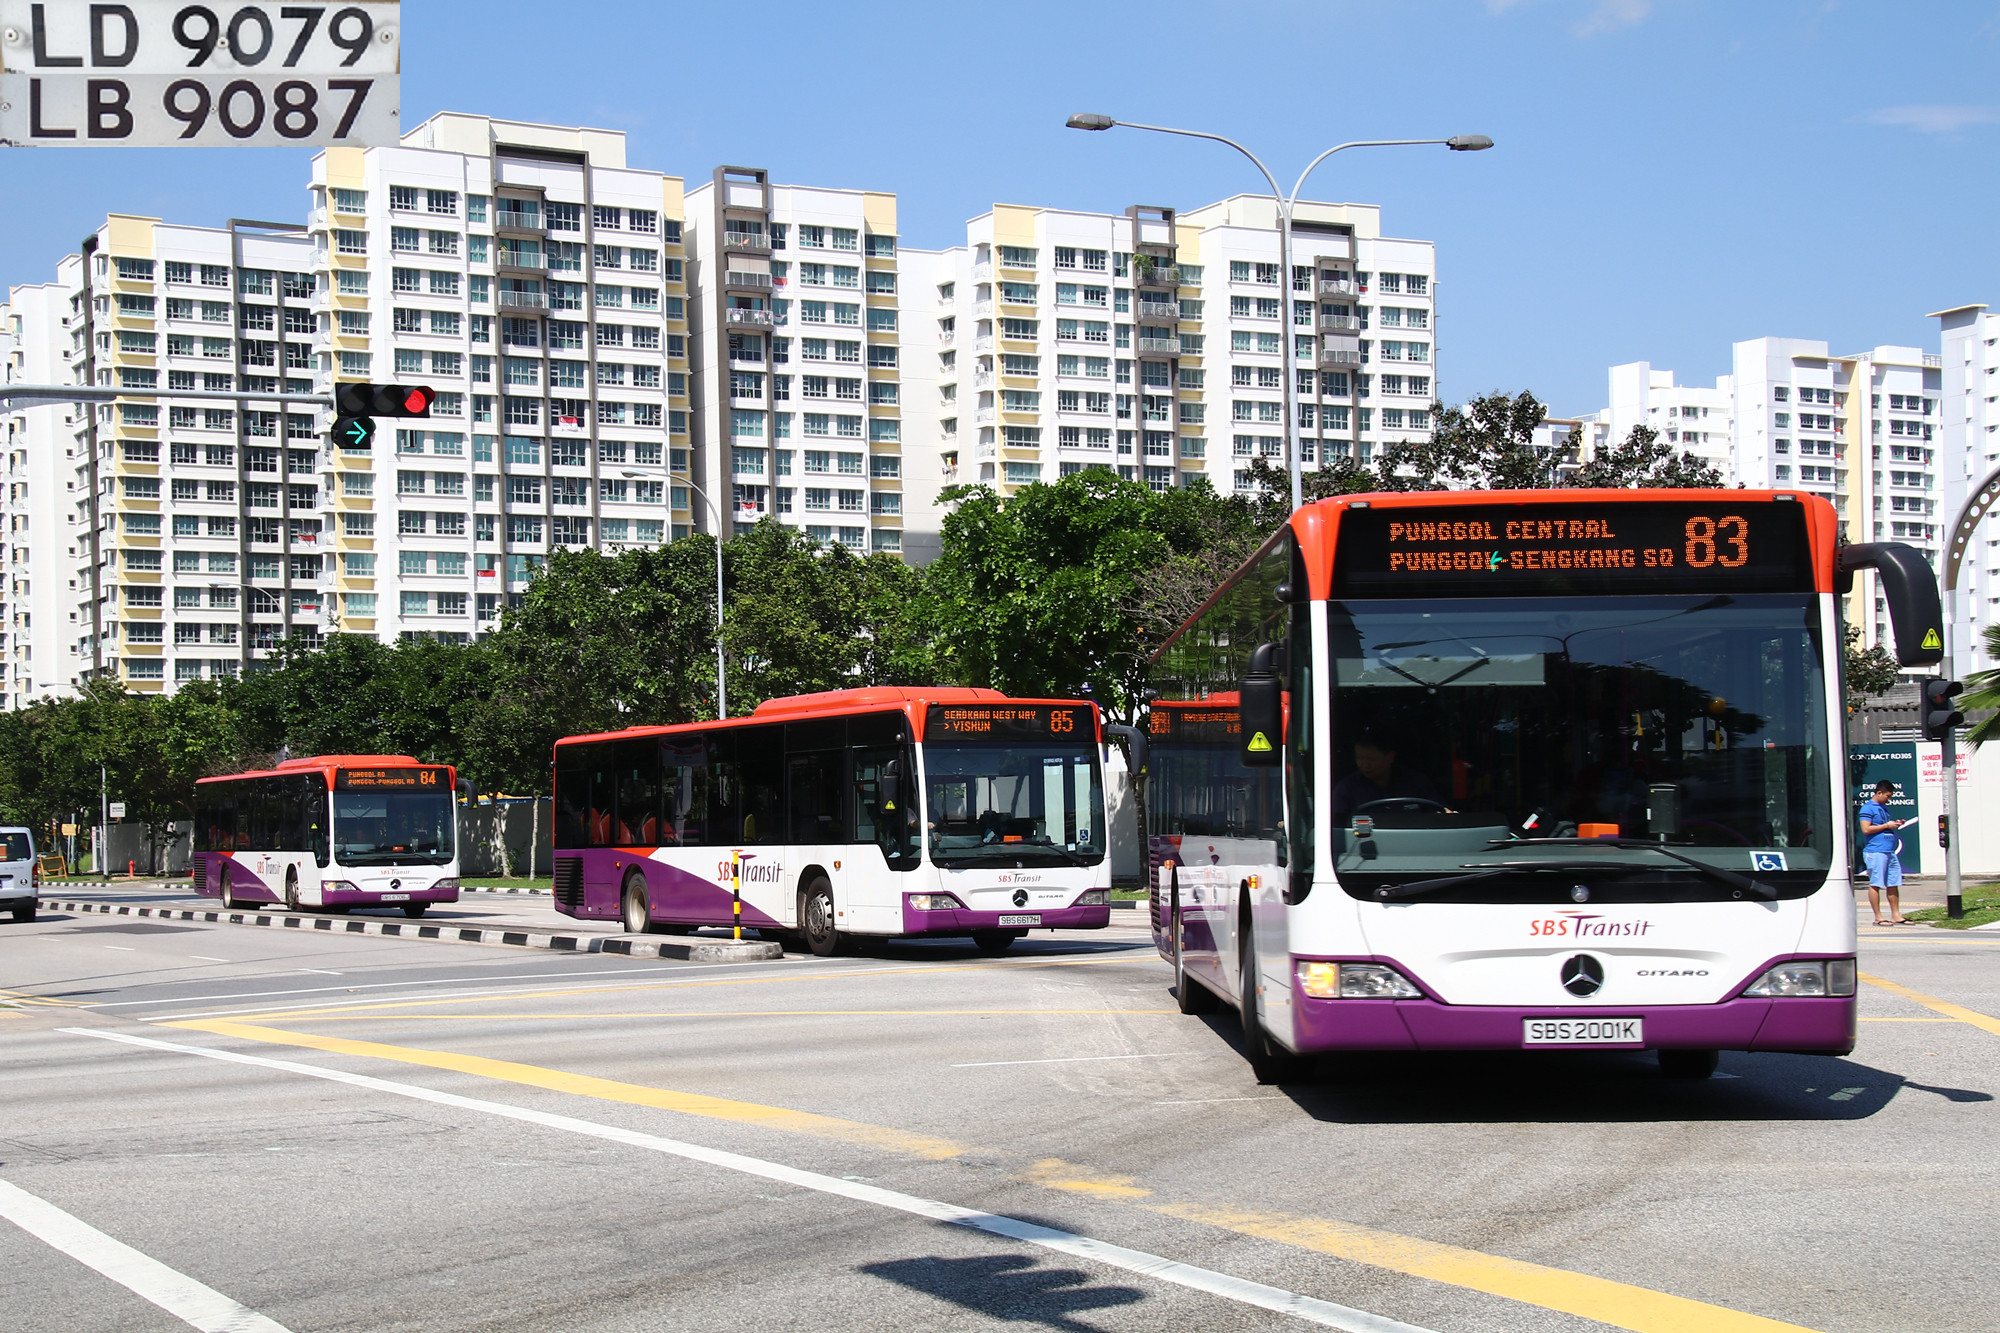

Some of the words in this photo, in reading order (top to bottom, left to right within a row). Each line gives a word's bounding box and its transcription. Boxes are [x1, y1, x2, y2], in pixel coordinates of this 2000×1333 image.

[1390, 521, 1499, 541] PUNGGOL
[1506, 519, 1616, 540] CENTRAL
[1685, 516, 1748, 567] 83
[1643, 548, 1674, 567] SQ
[993, 711, 1017, 719] WEST
[1018, 711, 1036, 719] WAY
[1050, 711, 1073, 732] 85
[953, 721, 991, 732] YISHUN
[420, 771, 436, 785] 84
[738, 854, 784, 887] Transit
[1012, 873, 1043, 883] Transit
[1530, 920, 1568, 936] SBS
[1564, 915, 1656, 938] Transit
